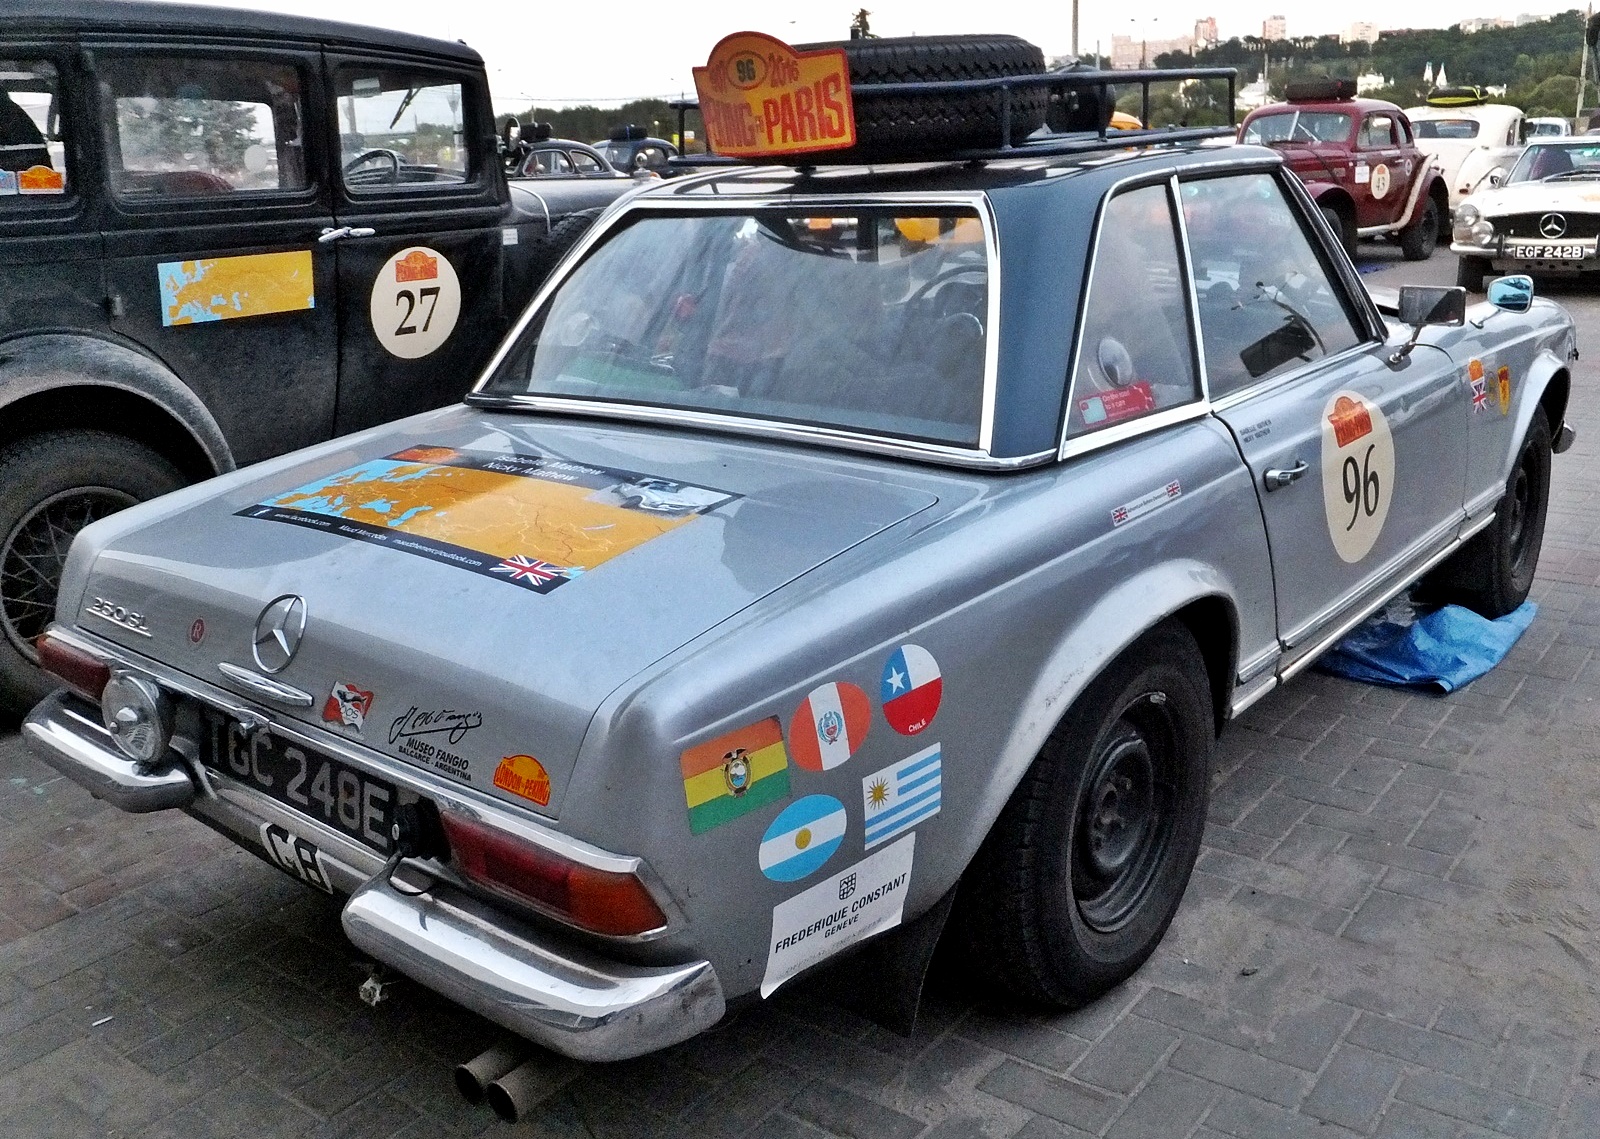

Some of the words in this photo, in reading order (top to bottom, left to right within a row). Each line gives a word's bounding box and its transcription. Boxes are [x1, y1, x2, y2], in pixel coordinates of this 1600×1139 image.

[735, 58, 757, 82] 96
[763, 73, 846, 145] PARIS
[1516, 246, 1543, 258] EGF
[1544, 246, 1582, 258] 242B
[395, 286, 441, 337] 27
[1342, 444, 1380, 531] 96
[93, 597, 128, 622] 250
[128, 612, 150, 631] SL
[908, 718, 927, 733] CHILE
[398, 746, 431, 764] BALCARCE
[434, 761, 472, 781] ARGENTINA
[406, 737, 435, 756] MUSEO
[435, 749, 469, 770] FANGIO
[285, 747, 390, 849] 248E
[775, 906, 848, 953] FREDERIQUE
[851, 873, 907, 913] CONSTANT
[824, 914, 860, 938] GENEVE
